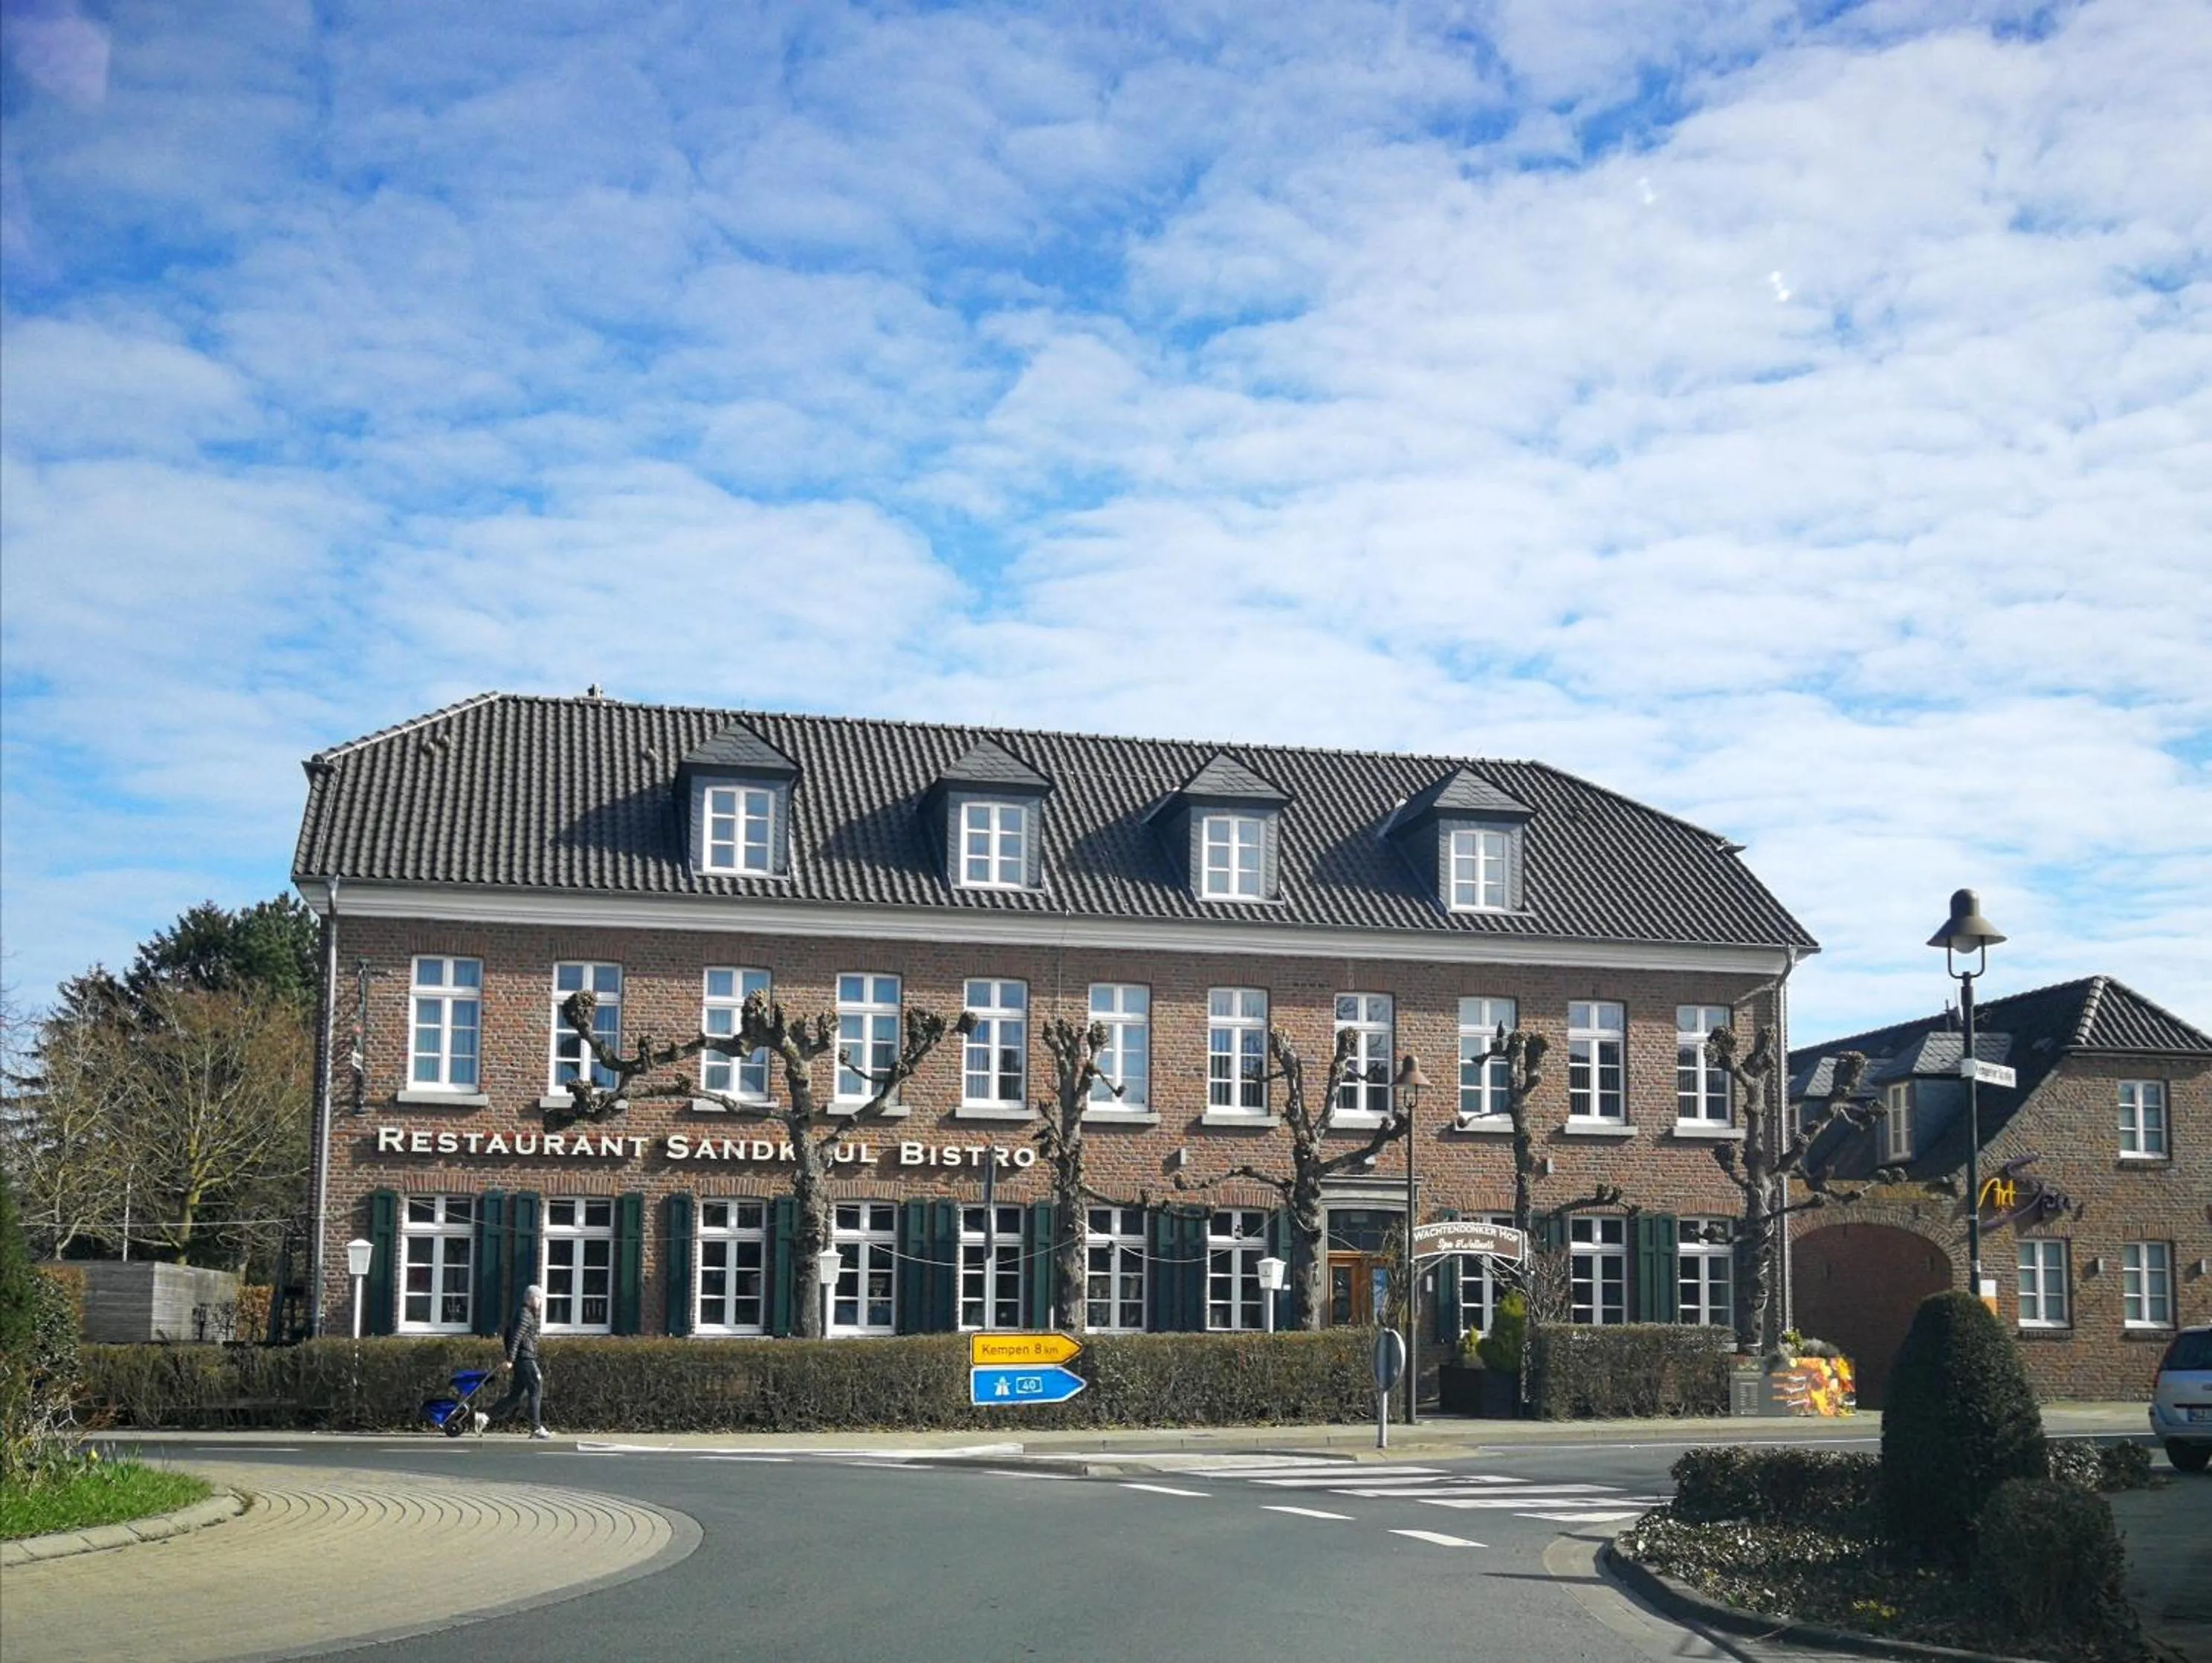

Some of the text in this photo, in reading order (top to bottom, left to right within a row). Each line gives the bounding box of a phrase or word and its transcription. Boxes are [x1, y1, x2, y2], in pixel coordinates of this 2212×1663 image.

[378, 1126, 1035, 1167] RESTAURANT SANDKUL BISTRO
[1978, 1177, 2017, 1209] Art
[1413, 1225, 1497, 1242] WACHTENDONKER
[982, 1343, 1059, 1357] Kempen 8 km
[1022, 1380, 1036, 1390] 40
